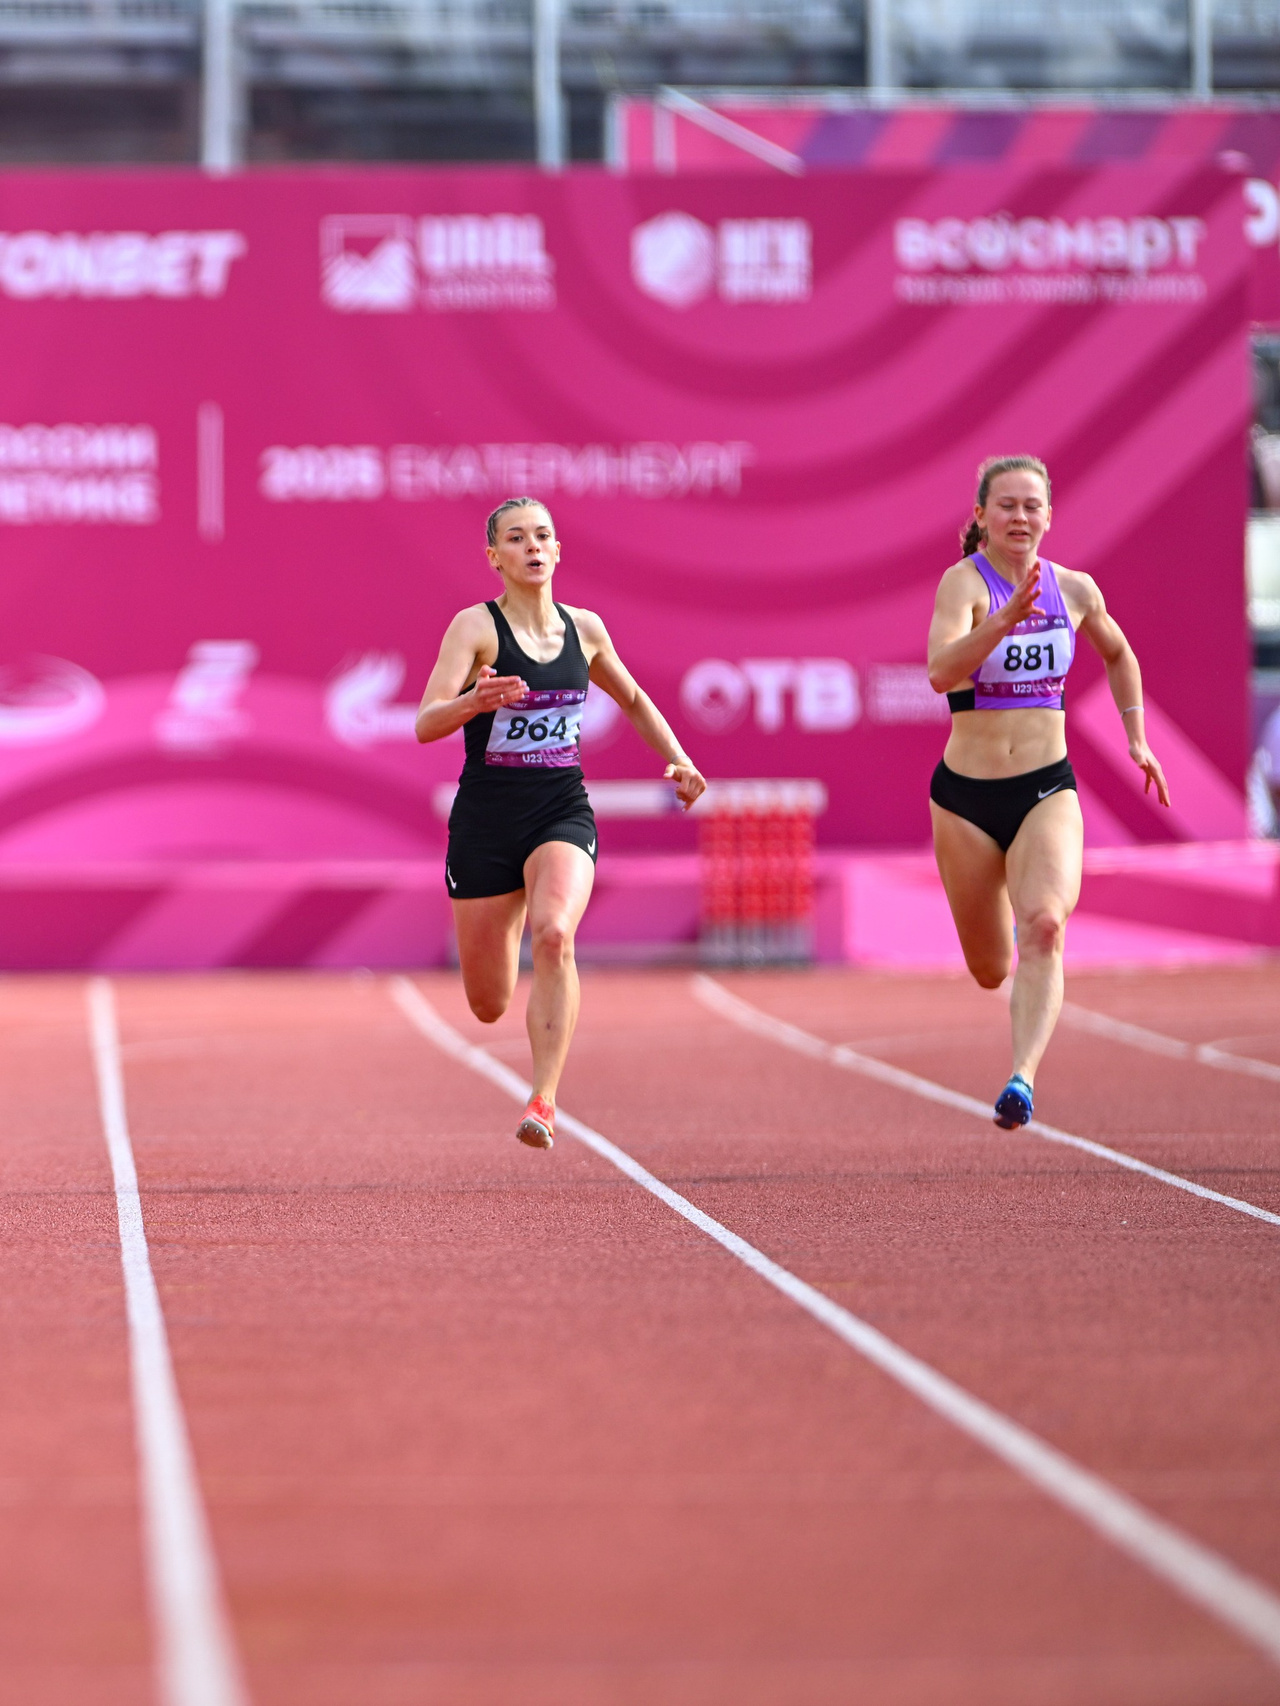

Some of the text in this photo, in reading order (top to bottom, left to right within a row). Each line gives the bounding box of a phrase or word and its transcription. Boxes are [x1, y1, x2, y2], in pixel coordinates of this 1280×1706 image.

[260, 442, 754, 499] 2025 ЕКАТЕРИНБУРГ
[1003, 643, 1054, 671] 881
[678, 657, 862, 734] ОТВ
[1012, 683, 1032, 693] U23
[506, 715, 566, 742] 864
[522, 753, 543, 764] U23
